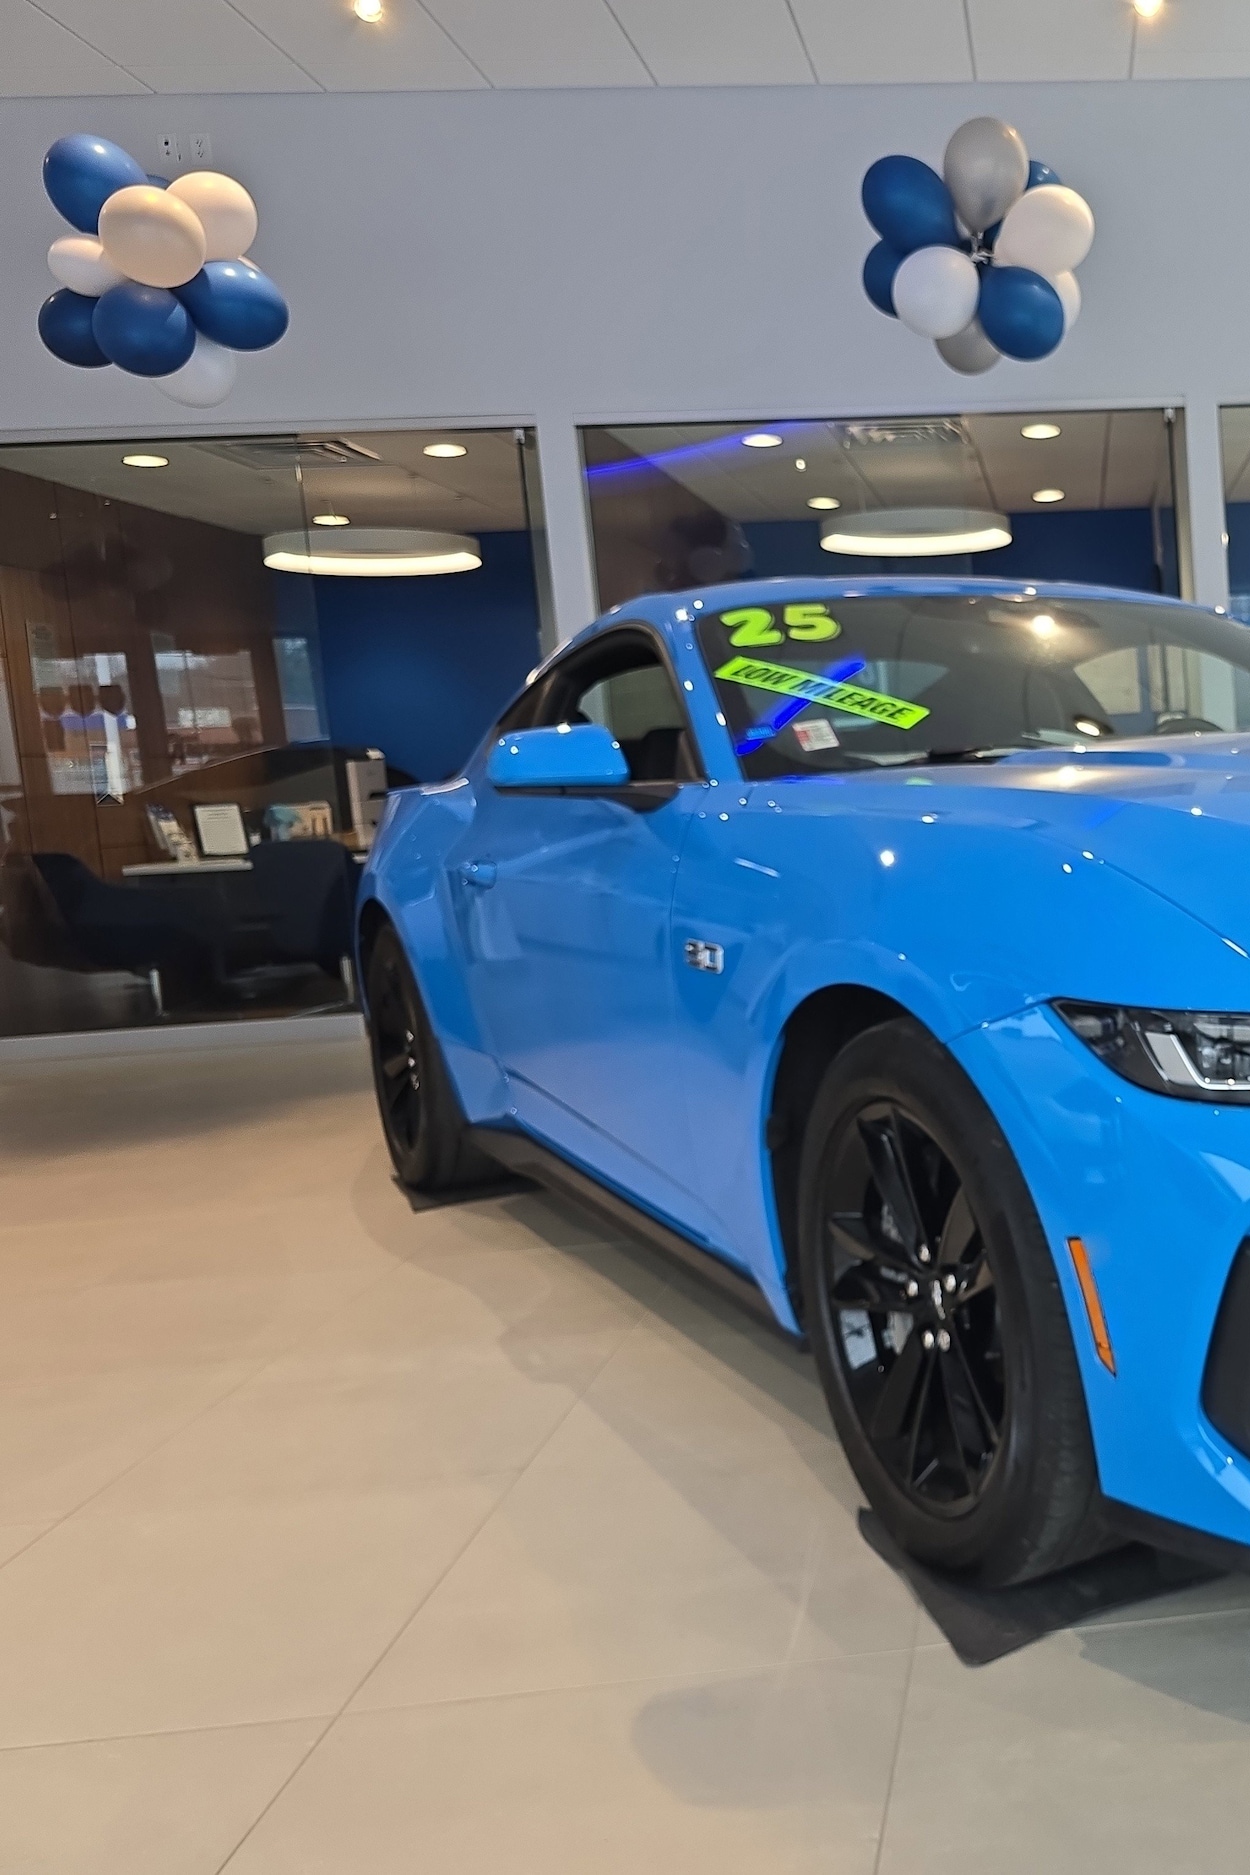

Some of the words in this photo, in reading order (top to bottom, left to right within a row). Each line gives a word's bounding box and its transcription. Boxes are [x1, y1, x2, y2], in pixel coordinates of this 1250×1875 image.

[719, 603, 841, 647] 25
[733, 665, 794, 686] LOW
[790, 679, 914, 720] MILEAGE
